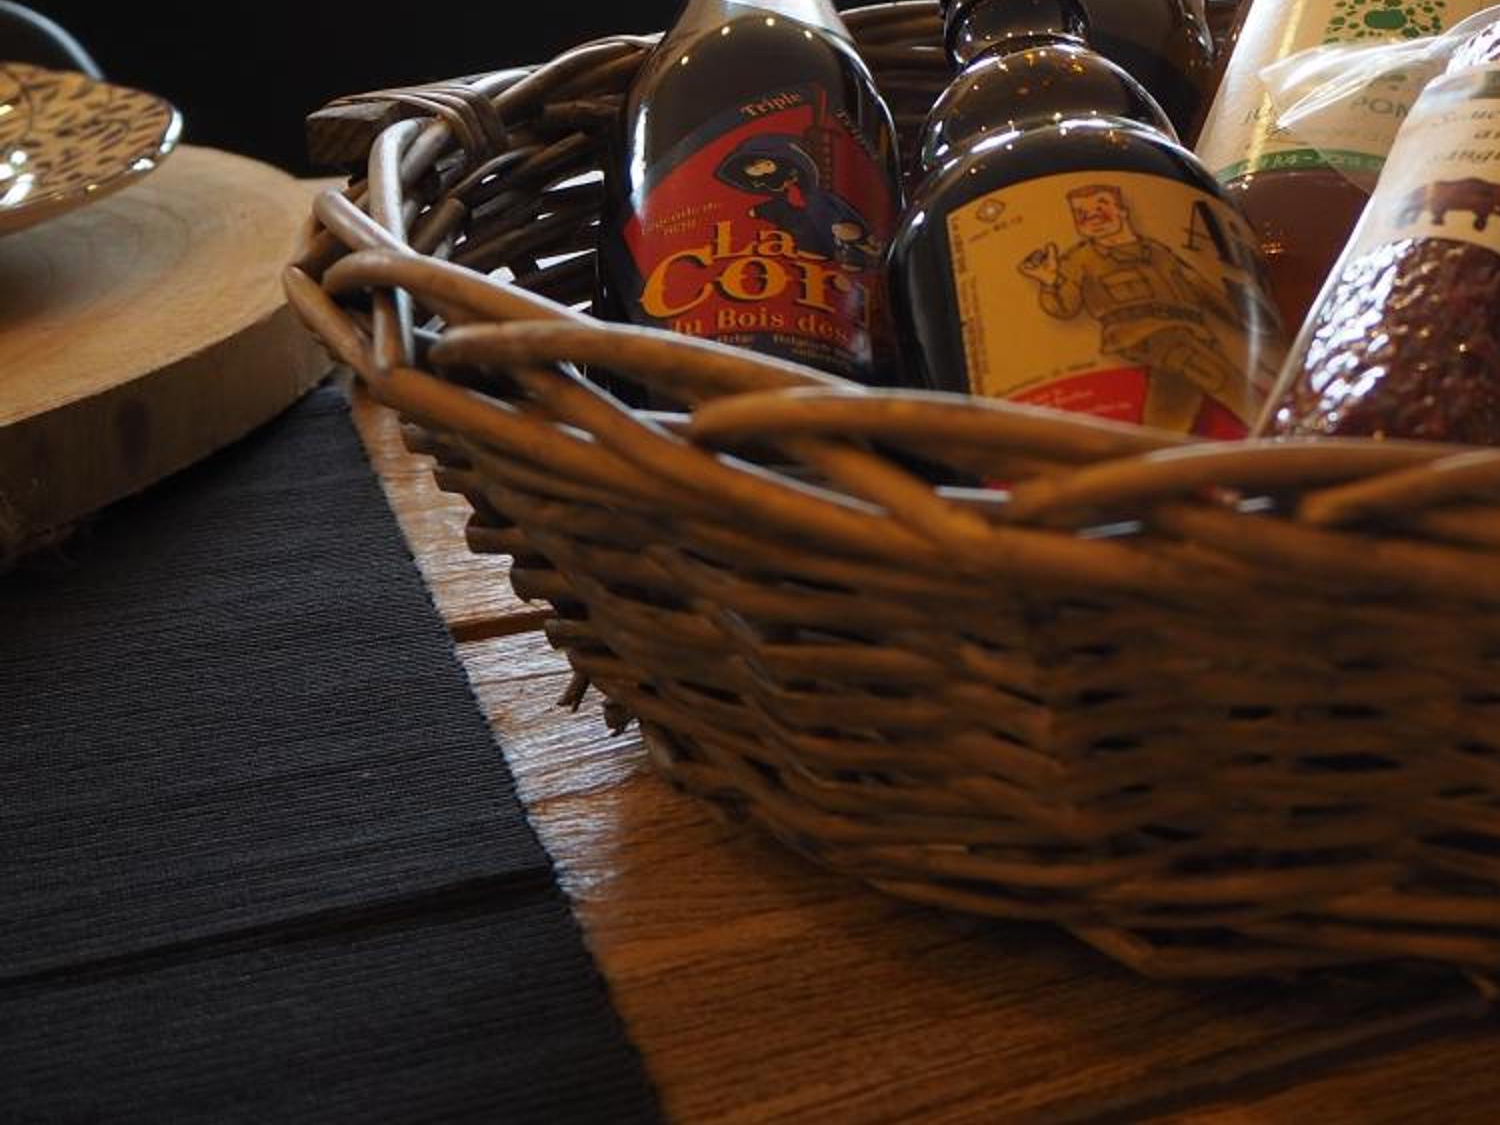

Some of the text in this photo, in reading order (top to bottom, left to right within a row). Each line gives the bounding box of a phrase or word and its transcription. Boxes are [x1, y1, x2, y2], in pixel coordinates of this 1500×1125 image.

[740, 89, 803, 118] Triple
[711, 219, 828, 261] La
[717, 306, 786, 330] Bois
